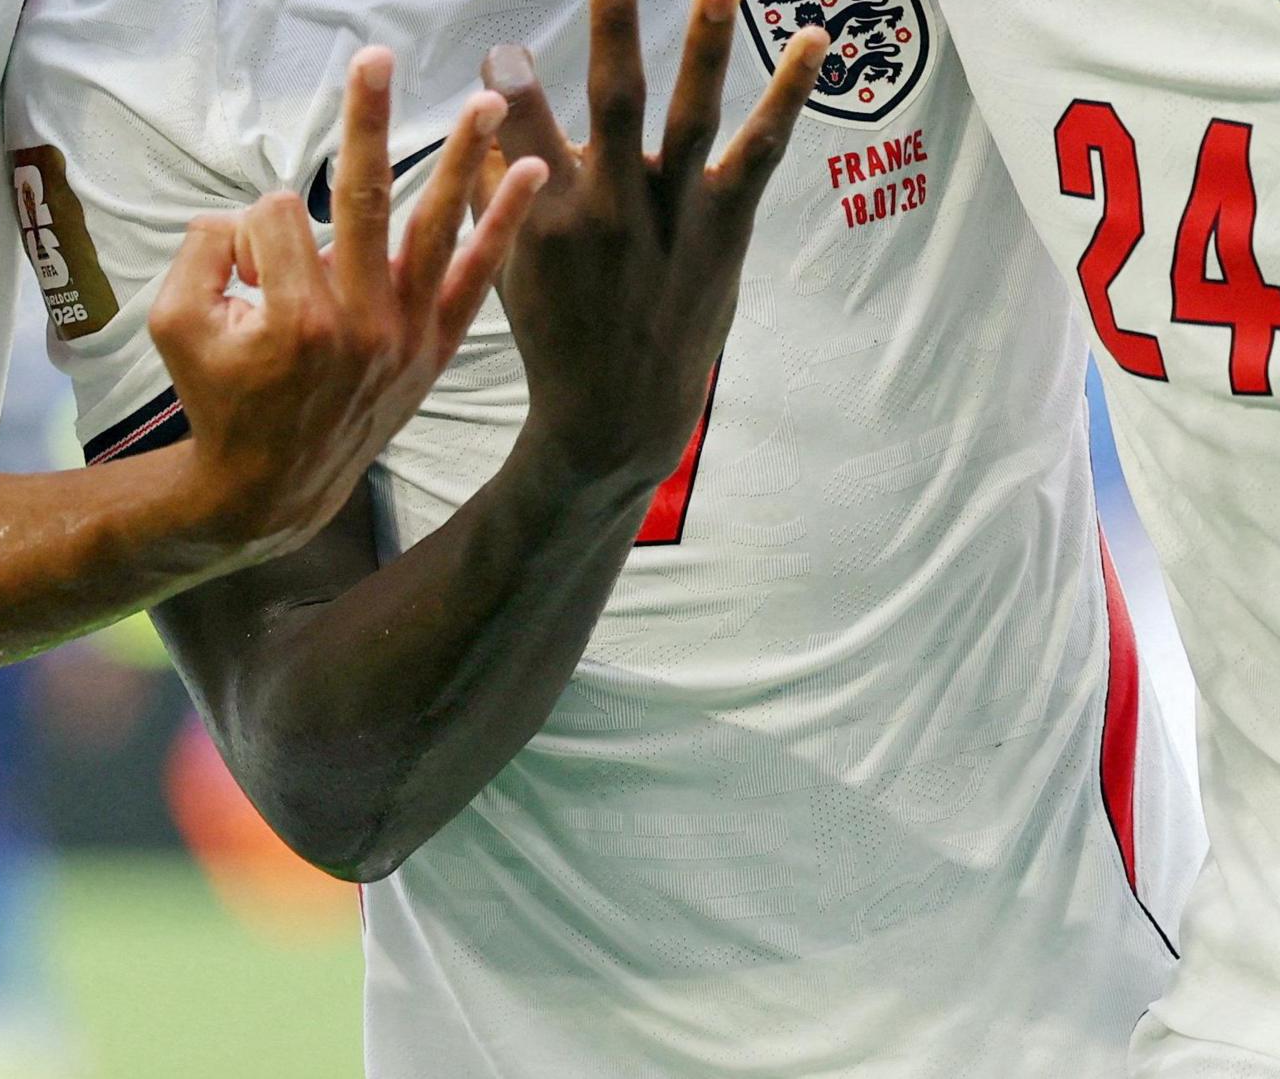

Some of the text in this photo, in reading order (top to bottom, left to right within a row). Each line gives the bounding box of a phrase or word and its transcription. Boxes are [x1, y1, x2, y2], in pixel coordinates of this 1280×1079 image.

[827, 129, 928, 188] FRANCE
[841, 173, 927, 228] 18.07.26
[51, 304, 88, 326] 026
[63, 290, 79, 303] CUP
